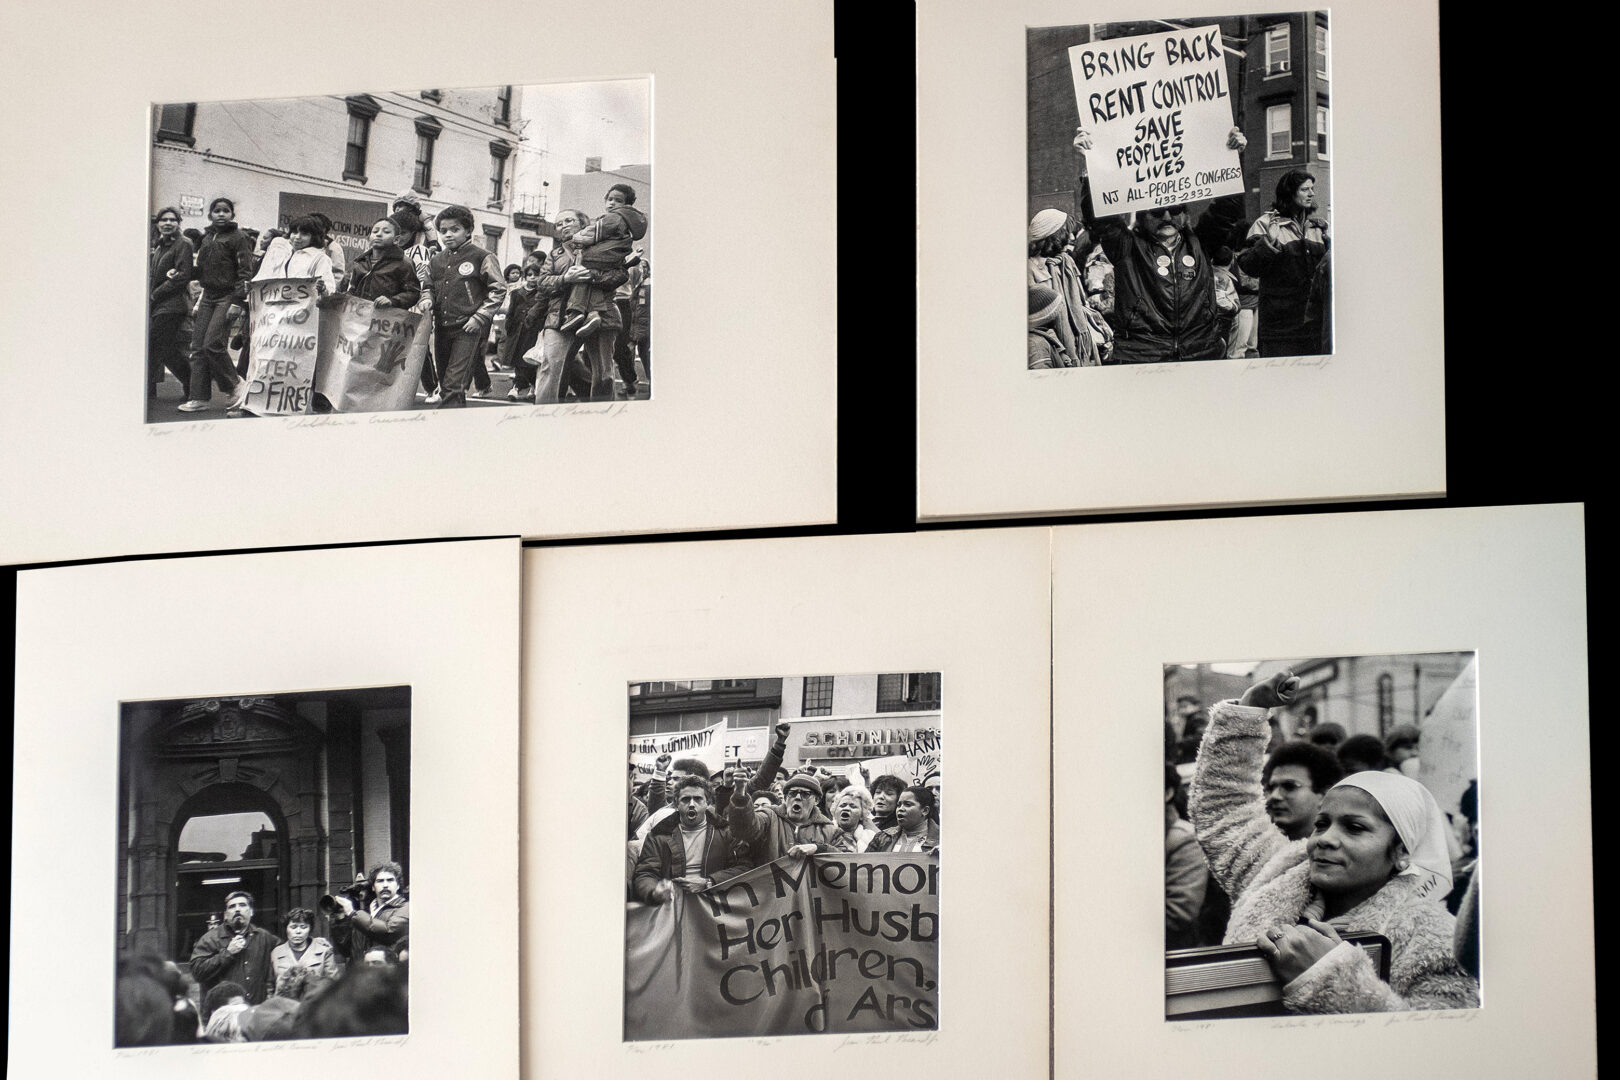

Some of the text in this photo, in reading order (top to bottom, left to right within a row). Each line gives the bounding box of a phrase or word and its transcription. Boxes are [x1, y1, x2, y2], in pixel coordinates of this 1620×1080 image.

[1081, 29, 1222, 80] BRING BACK
[1089, 69, 1228, 124] RENT CONTROL
[1134, 111, 1185, 143] SAVE
[1116, 136, 1184, 168] PEOPLES
[1135, 156, 1185, 183] LIVES
[1102, 167, 1242, 205] NJ ALL-PEOPLES CONGRESS
[1155, 187, 1213, 205] 433-2332
[717, 897, 939, 961] Her Husb
[847, 985, 938, 1030] Ars
